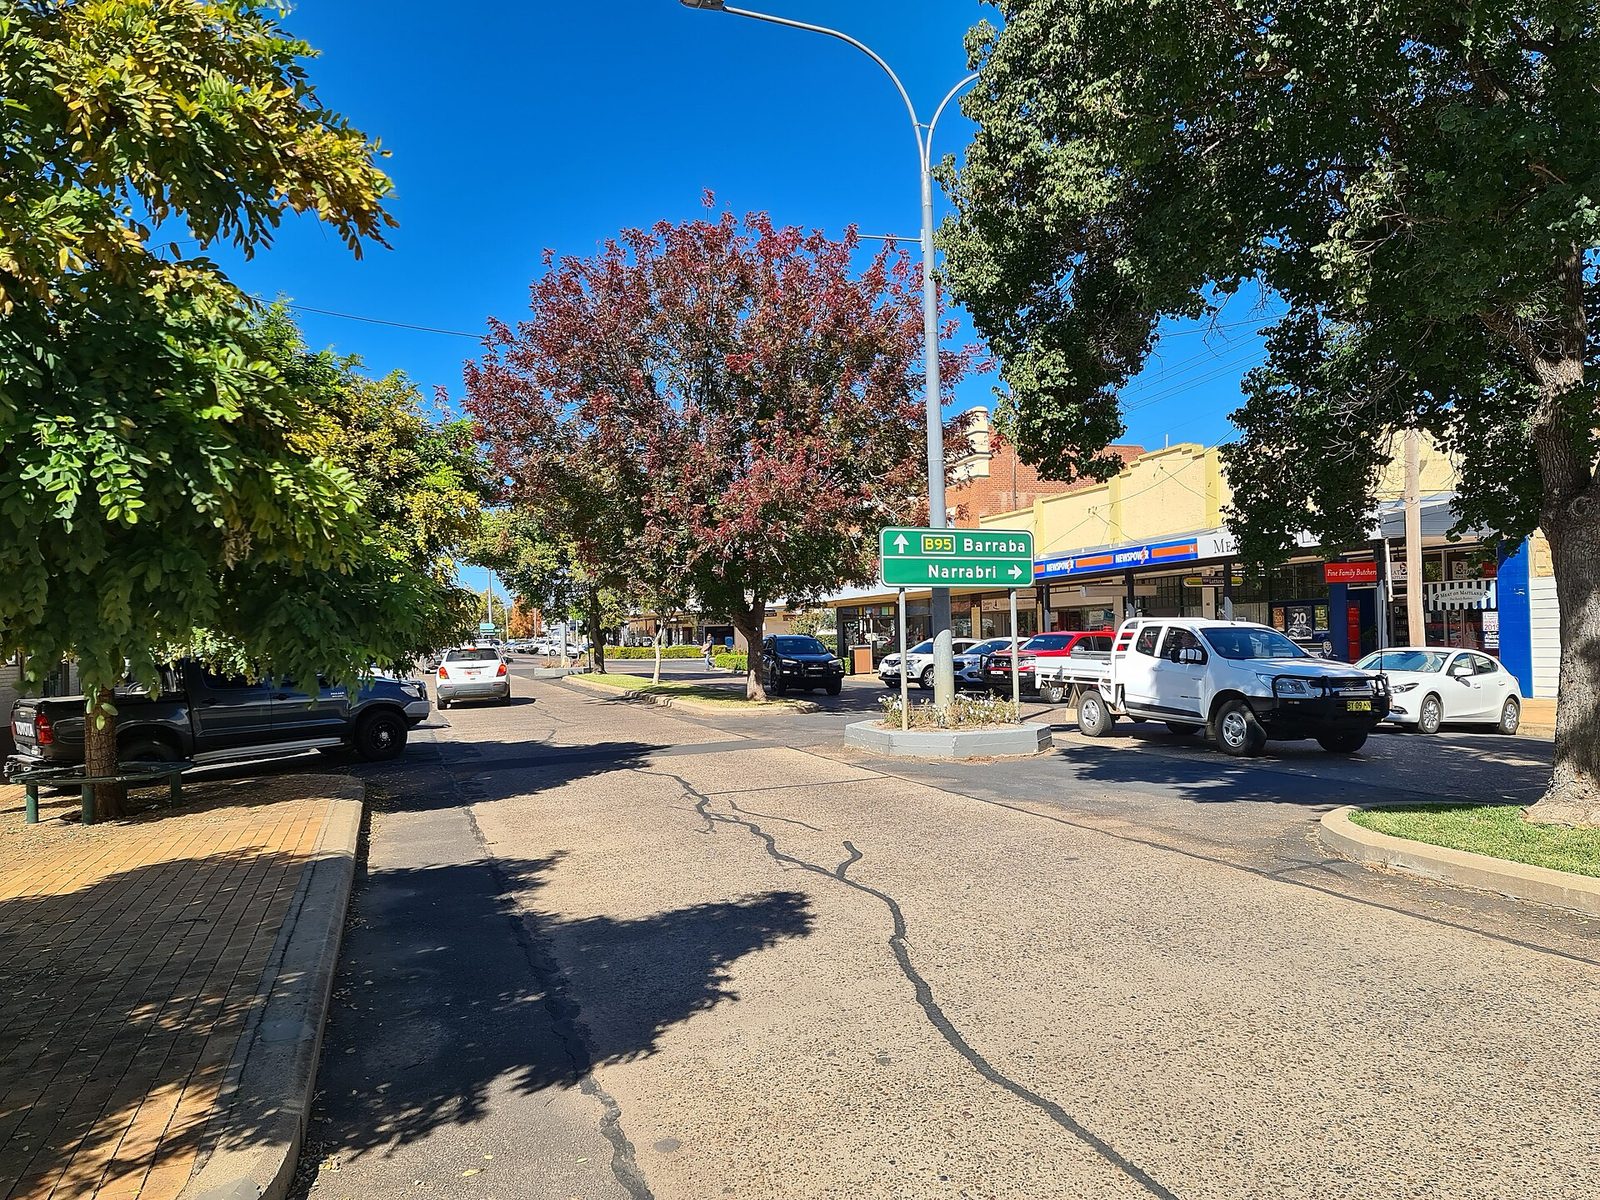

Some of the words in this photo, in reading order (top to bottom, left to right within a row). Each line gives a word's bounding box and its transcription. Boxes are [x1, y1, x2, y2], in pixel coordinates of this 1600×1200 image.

[925, 538, 952, 551] B95
[963, 538, 1026, 553] Barraba
[928, 564, 997, 579] Narrabri
[1327, 569, 1338, 577] Fine
[1339, 568, 1356, 578] Family
[1293, 612, 1307, 625] 20
